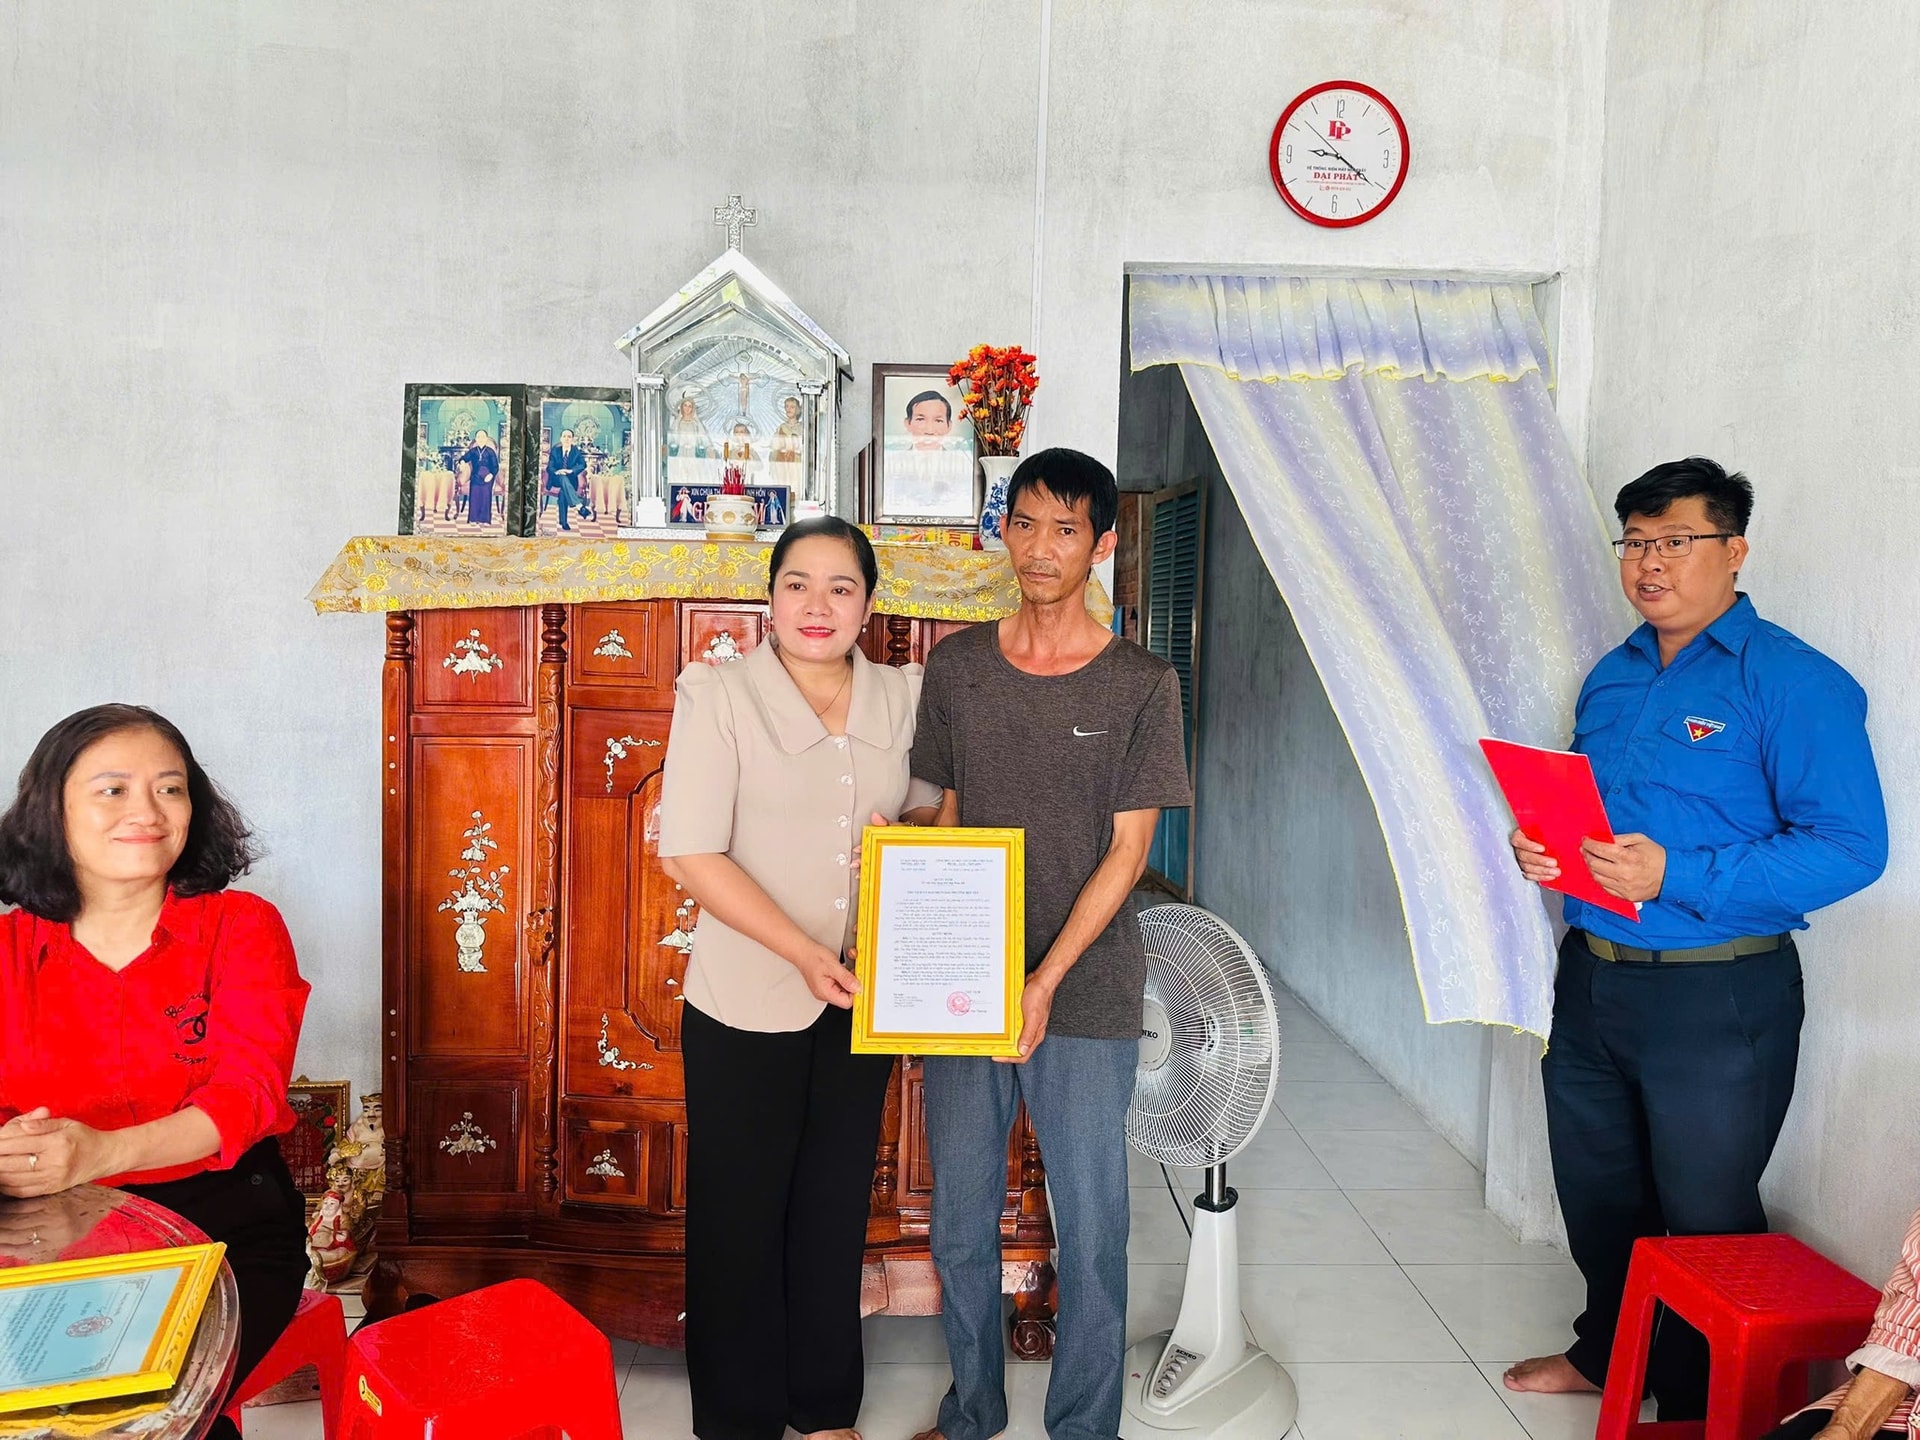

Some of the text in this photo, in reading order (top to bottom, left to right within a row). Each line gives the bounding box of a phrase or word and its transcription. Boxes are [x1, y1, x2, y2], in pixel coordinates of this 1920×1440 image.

[1336, 99, 1345, 118] 12
[1286, 144, 1292, 163] 9
[1383, 149, 1389, 168] 3
[1313, 171, 1358, 181] ĐẠI PHÁT
[1331, 195, 1337, 213] 6
[1141, 1029, 1158, 1039] NKO
